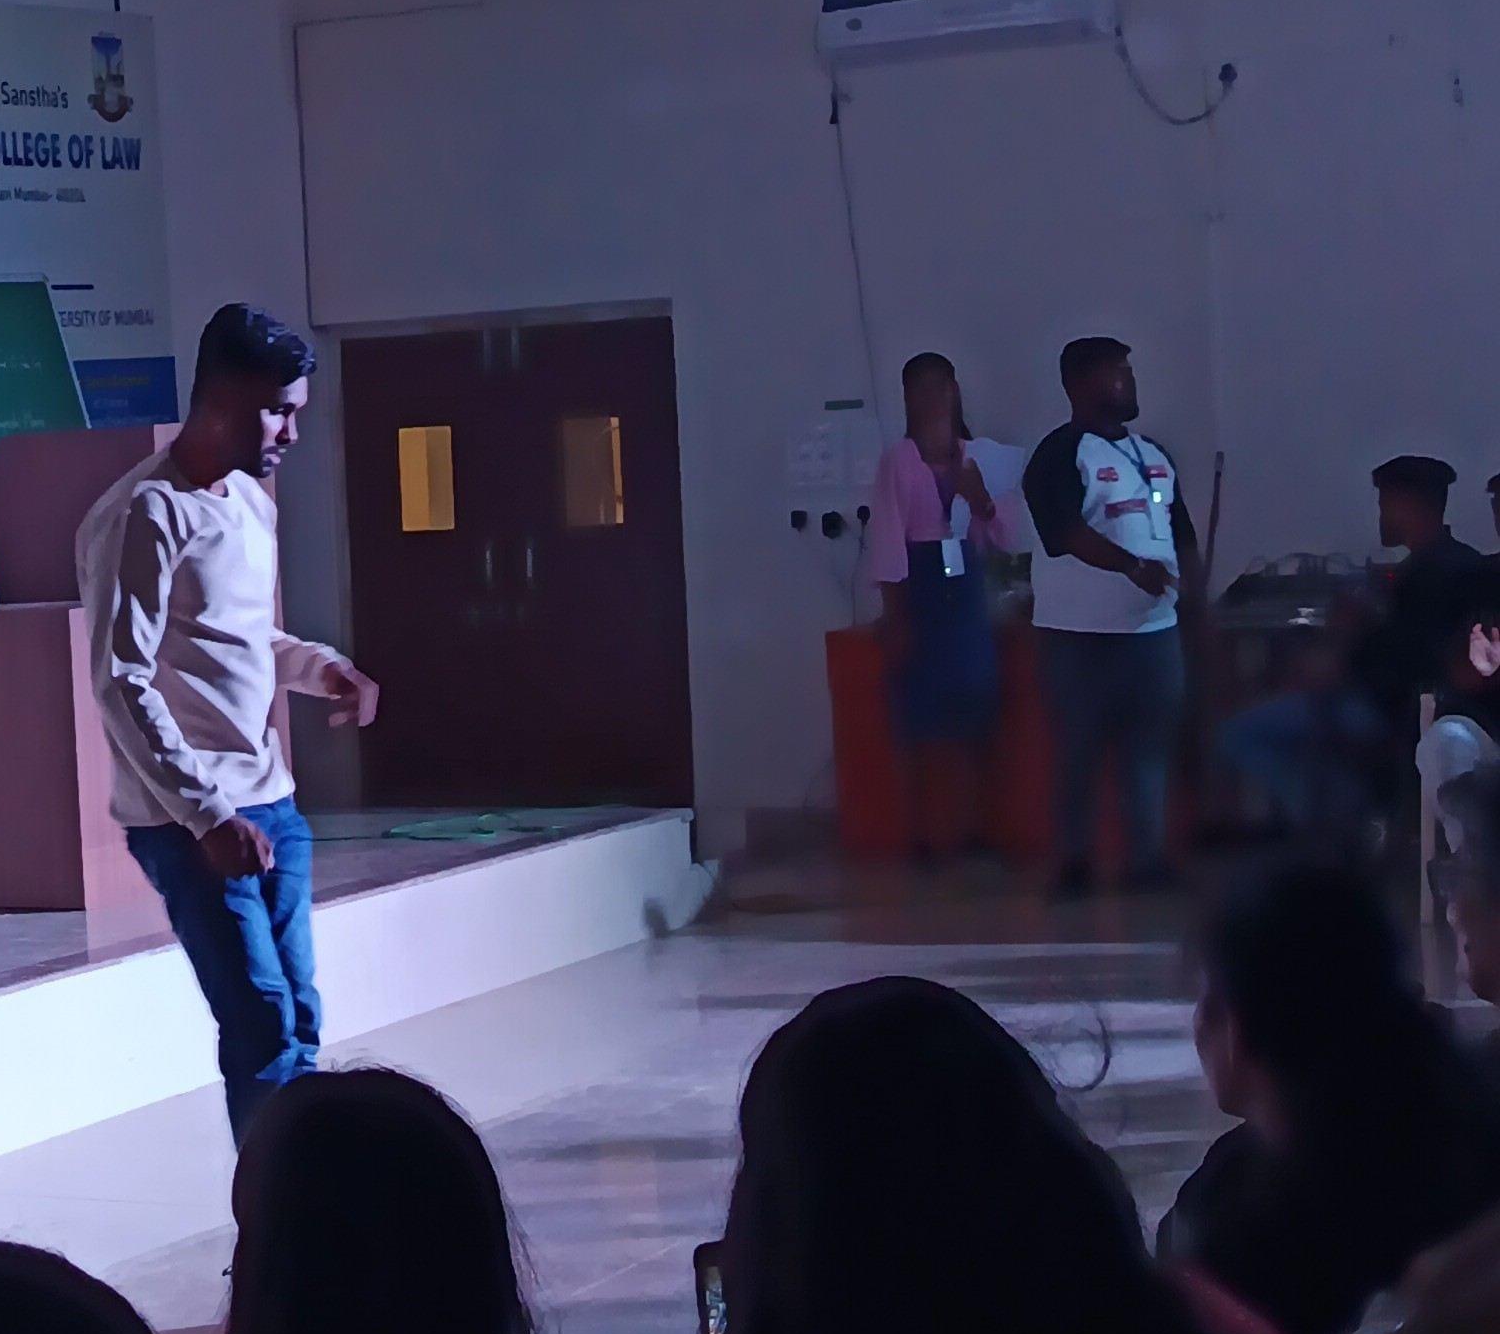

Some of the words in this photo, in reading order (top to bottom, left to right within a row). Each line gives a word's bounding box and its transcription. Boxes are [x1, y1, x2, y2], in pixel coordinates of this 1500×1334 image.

[1, 81, 69, 109] Sanstha's
[67, 134, 93, 169] OF
[100, 136, 141, 171] LAW
